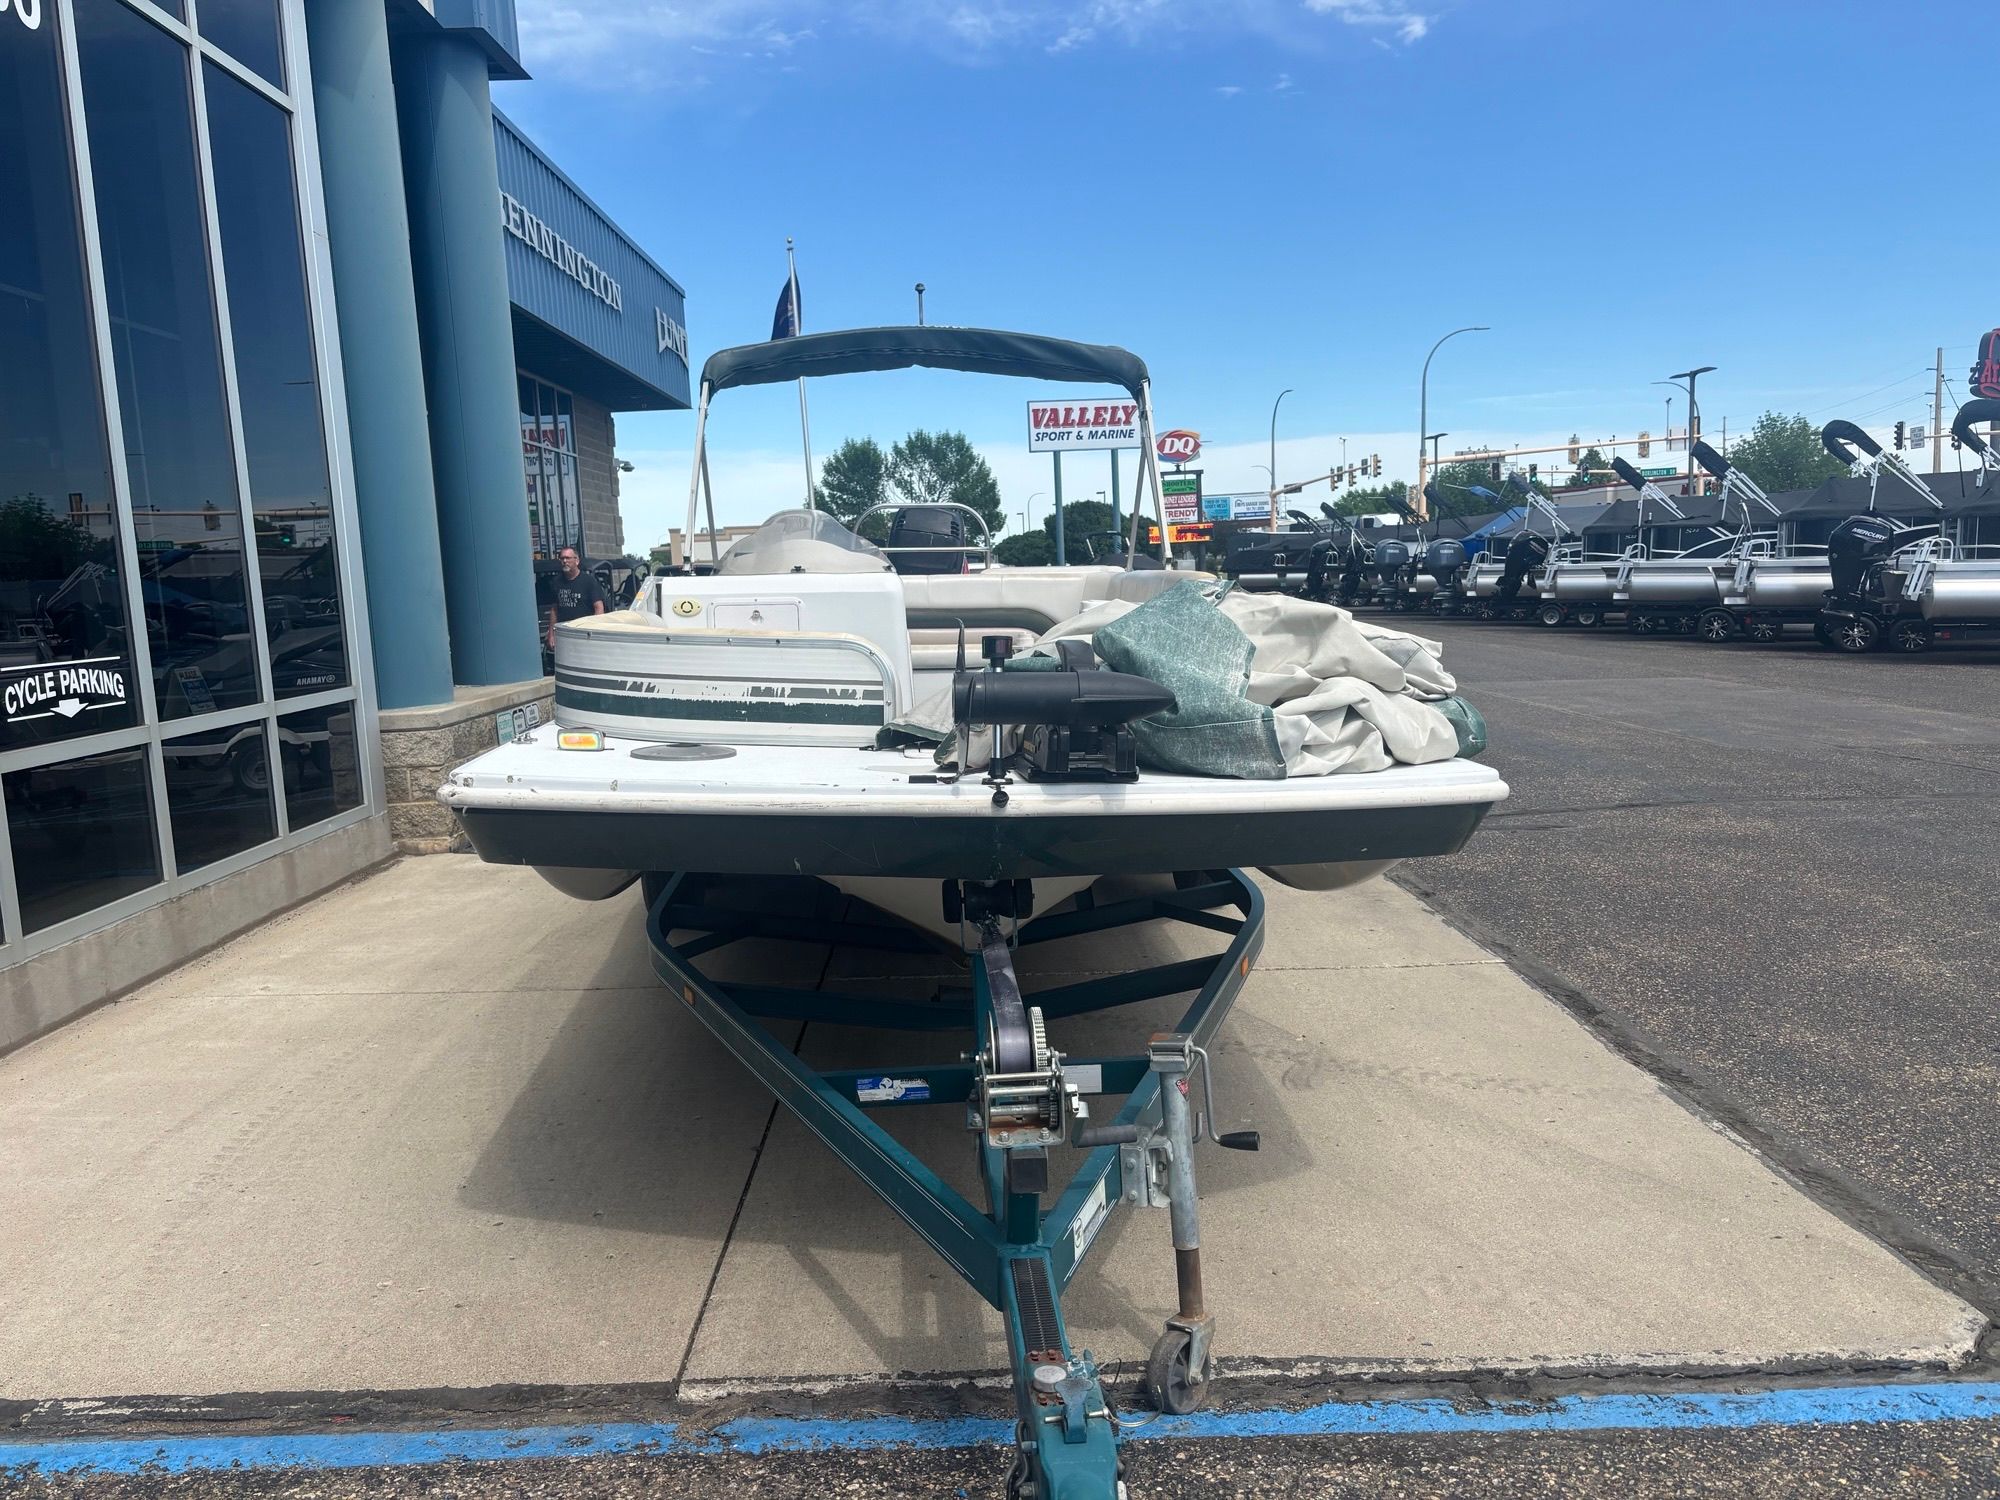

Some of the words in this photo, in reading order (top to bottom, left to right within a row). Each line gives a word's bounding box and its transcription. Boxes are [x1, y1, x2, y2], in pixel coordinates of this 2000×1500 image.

[501, 190, 623, 314] ENNINGTON
[1031, 405, 1137, 429] VALLELY
[1035, 431, 1072, 442] SPORT
[1076, 430, 1084, 440] &
[1088, 429, 1135, 440] MARINE
[1163, 436, 1195, 455] DQ
[1852, 527, 1887, 540] MERCURY
[5, 672, 57, 715] CYCLE
[59, 668, 125, 698] PARKING
